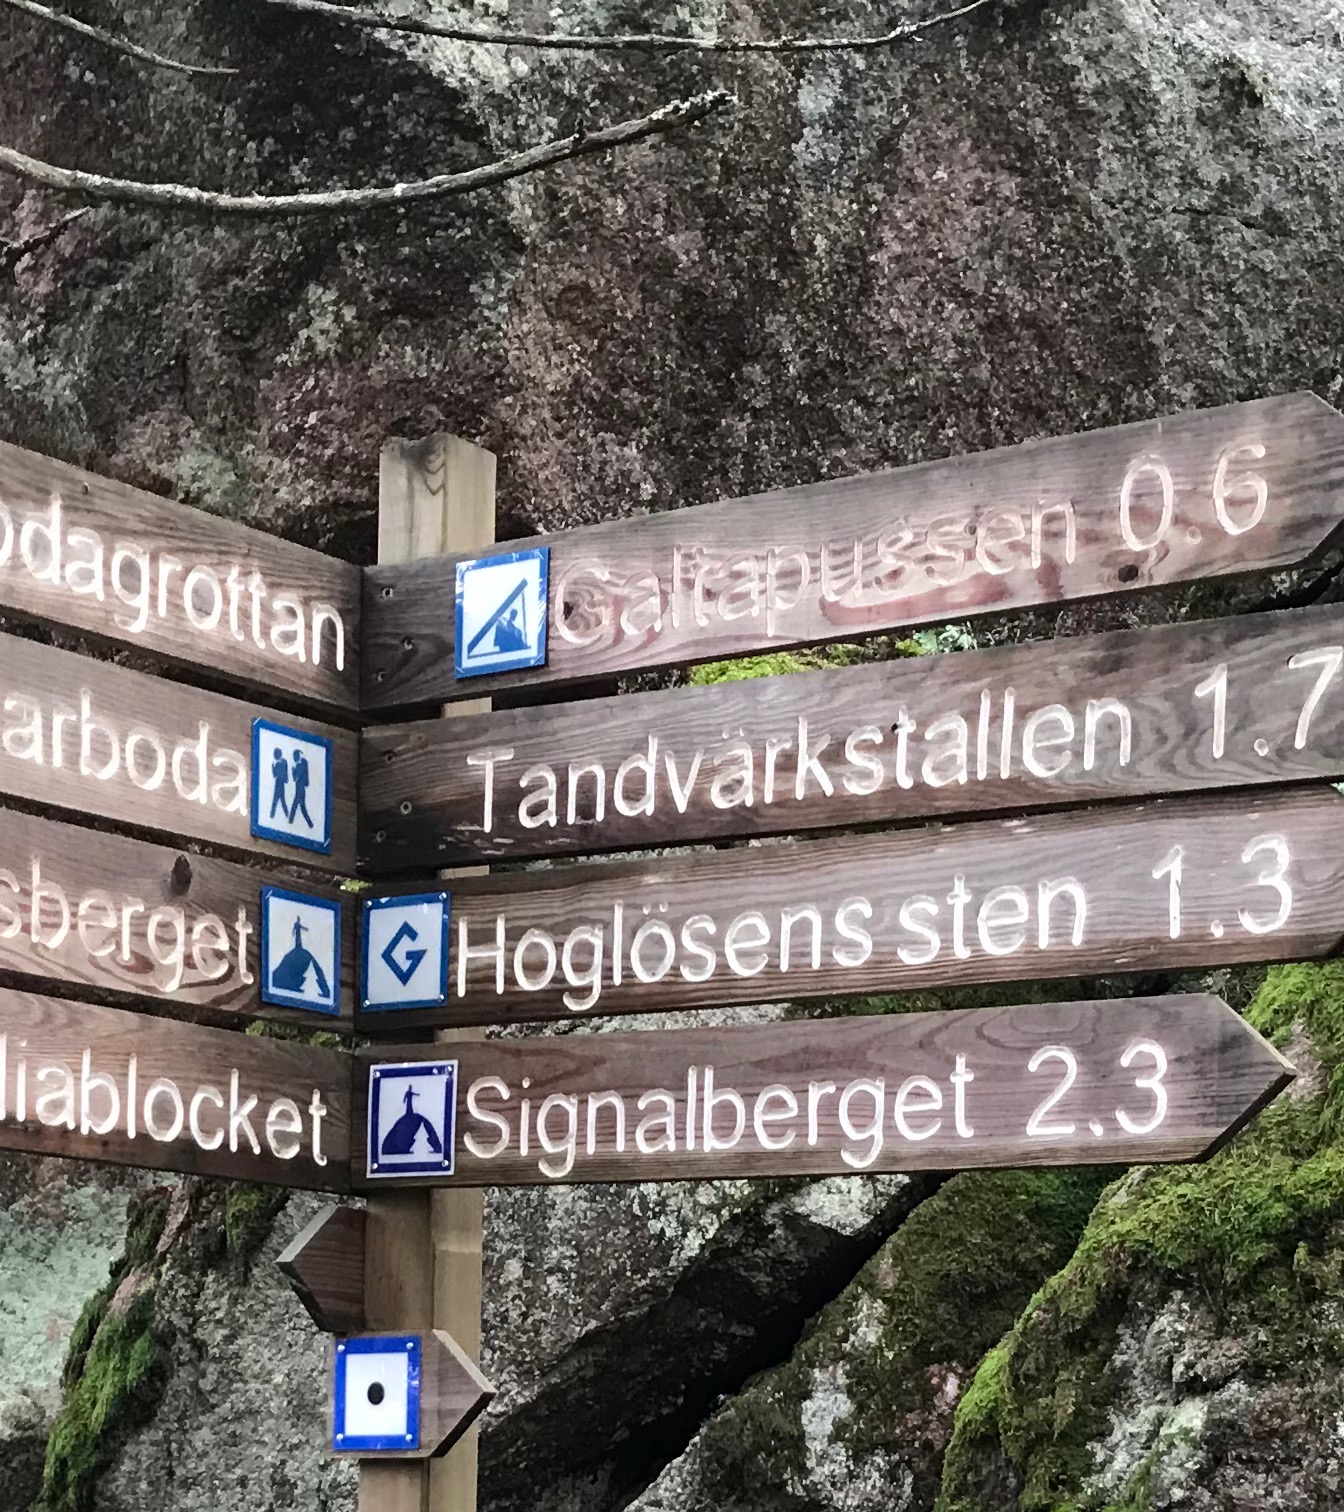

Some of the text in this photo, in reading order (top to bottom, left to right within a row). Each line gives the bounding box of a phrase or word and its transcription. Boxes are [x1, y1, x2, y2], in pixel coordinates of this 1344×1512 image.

[1119, 443, 1268, 552] 0.6
[1194, 645, 1344, 758] 1.7
[1151, 833, 1294, 939] 1.3
[462, 1037, 1169, 1179] Signalberget 2.3
